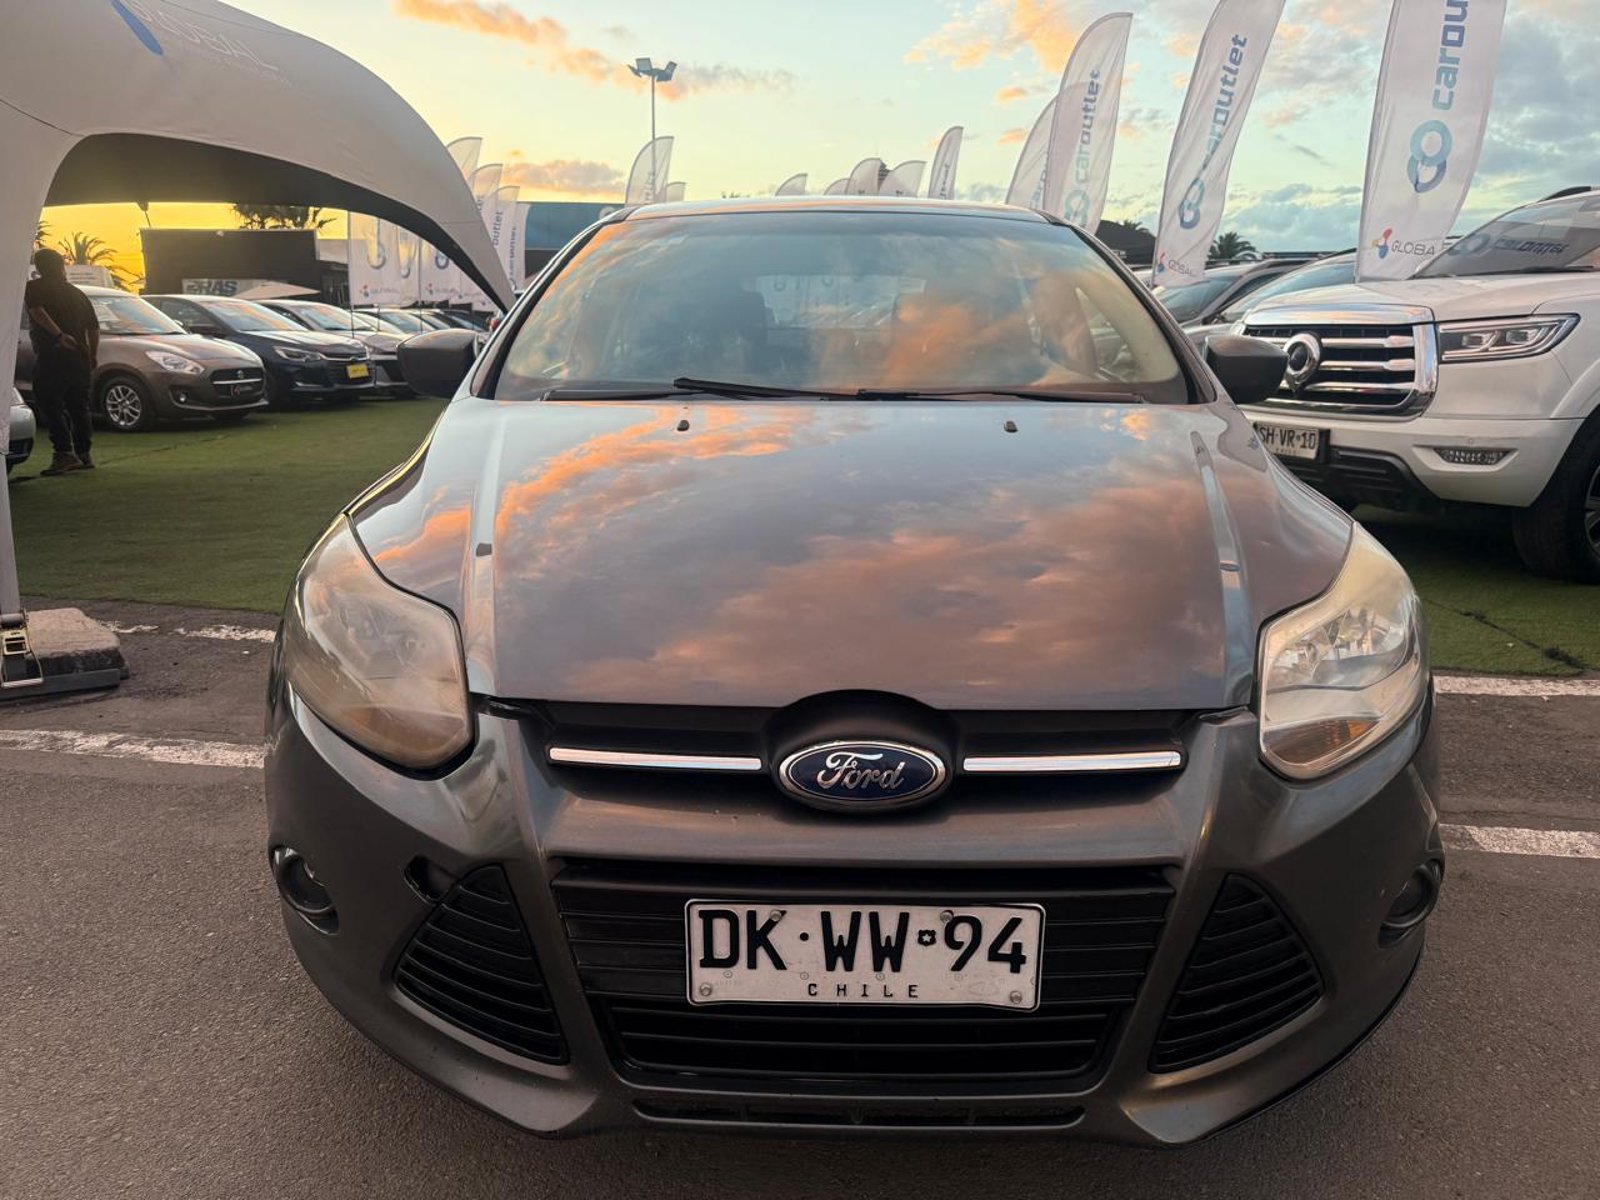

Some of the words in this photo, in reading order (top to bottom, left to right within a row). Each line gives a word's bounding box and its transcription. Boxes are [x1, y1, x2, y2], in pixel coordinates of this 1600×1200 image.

[1076, 69, 1099, 183] caroutlet
[816, 751, 906, 790] Ford
[807, 982, 919, 998] CHILE
